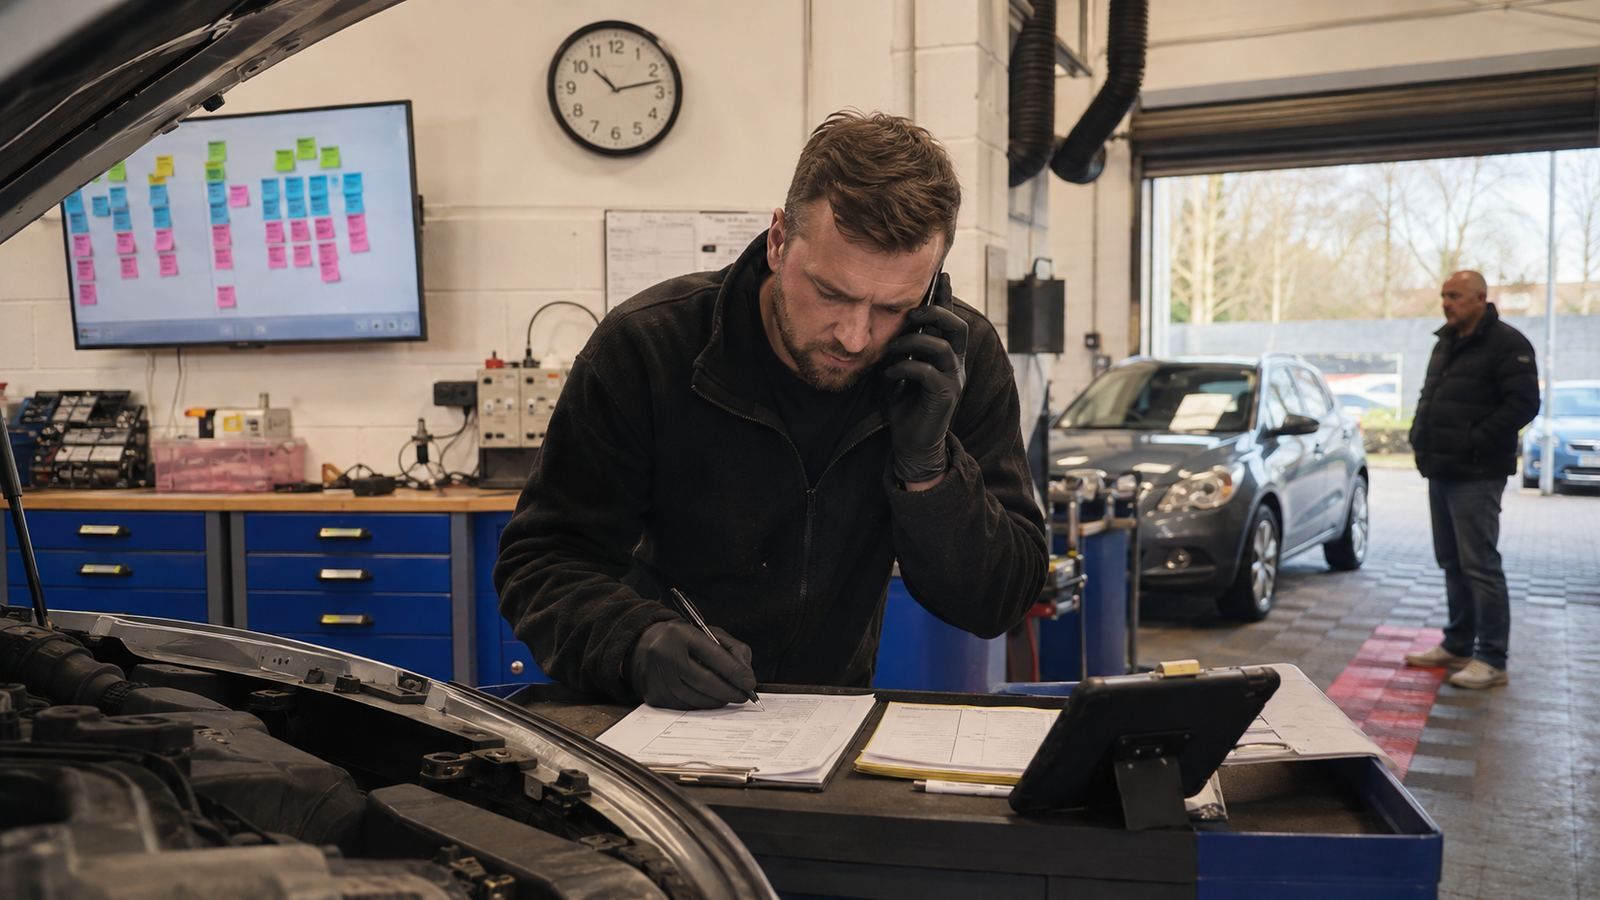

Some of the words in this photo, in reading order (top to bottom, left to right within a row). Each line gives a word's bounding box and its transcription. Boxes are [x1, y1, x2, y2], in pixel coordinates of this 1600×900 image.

[589, 45, 600, 58] 11
[608, 40, 624, 54] 12
[635, 47, 641, 60] 1
[573, 60, 588, 73] 10
[648, 63, 658, 77] 2
[566, 80, 576, 95] 9
[654, 85, 665, 99] 3
[573, 103, 583, 118] 8
[648, 107, 657, 119] 4
[590, 120, 599, 133] 7
[610, 126, 621, 140] 6
[633, 122, 642, 135] 5
